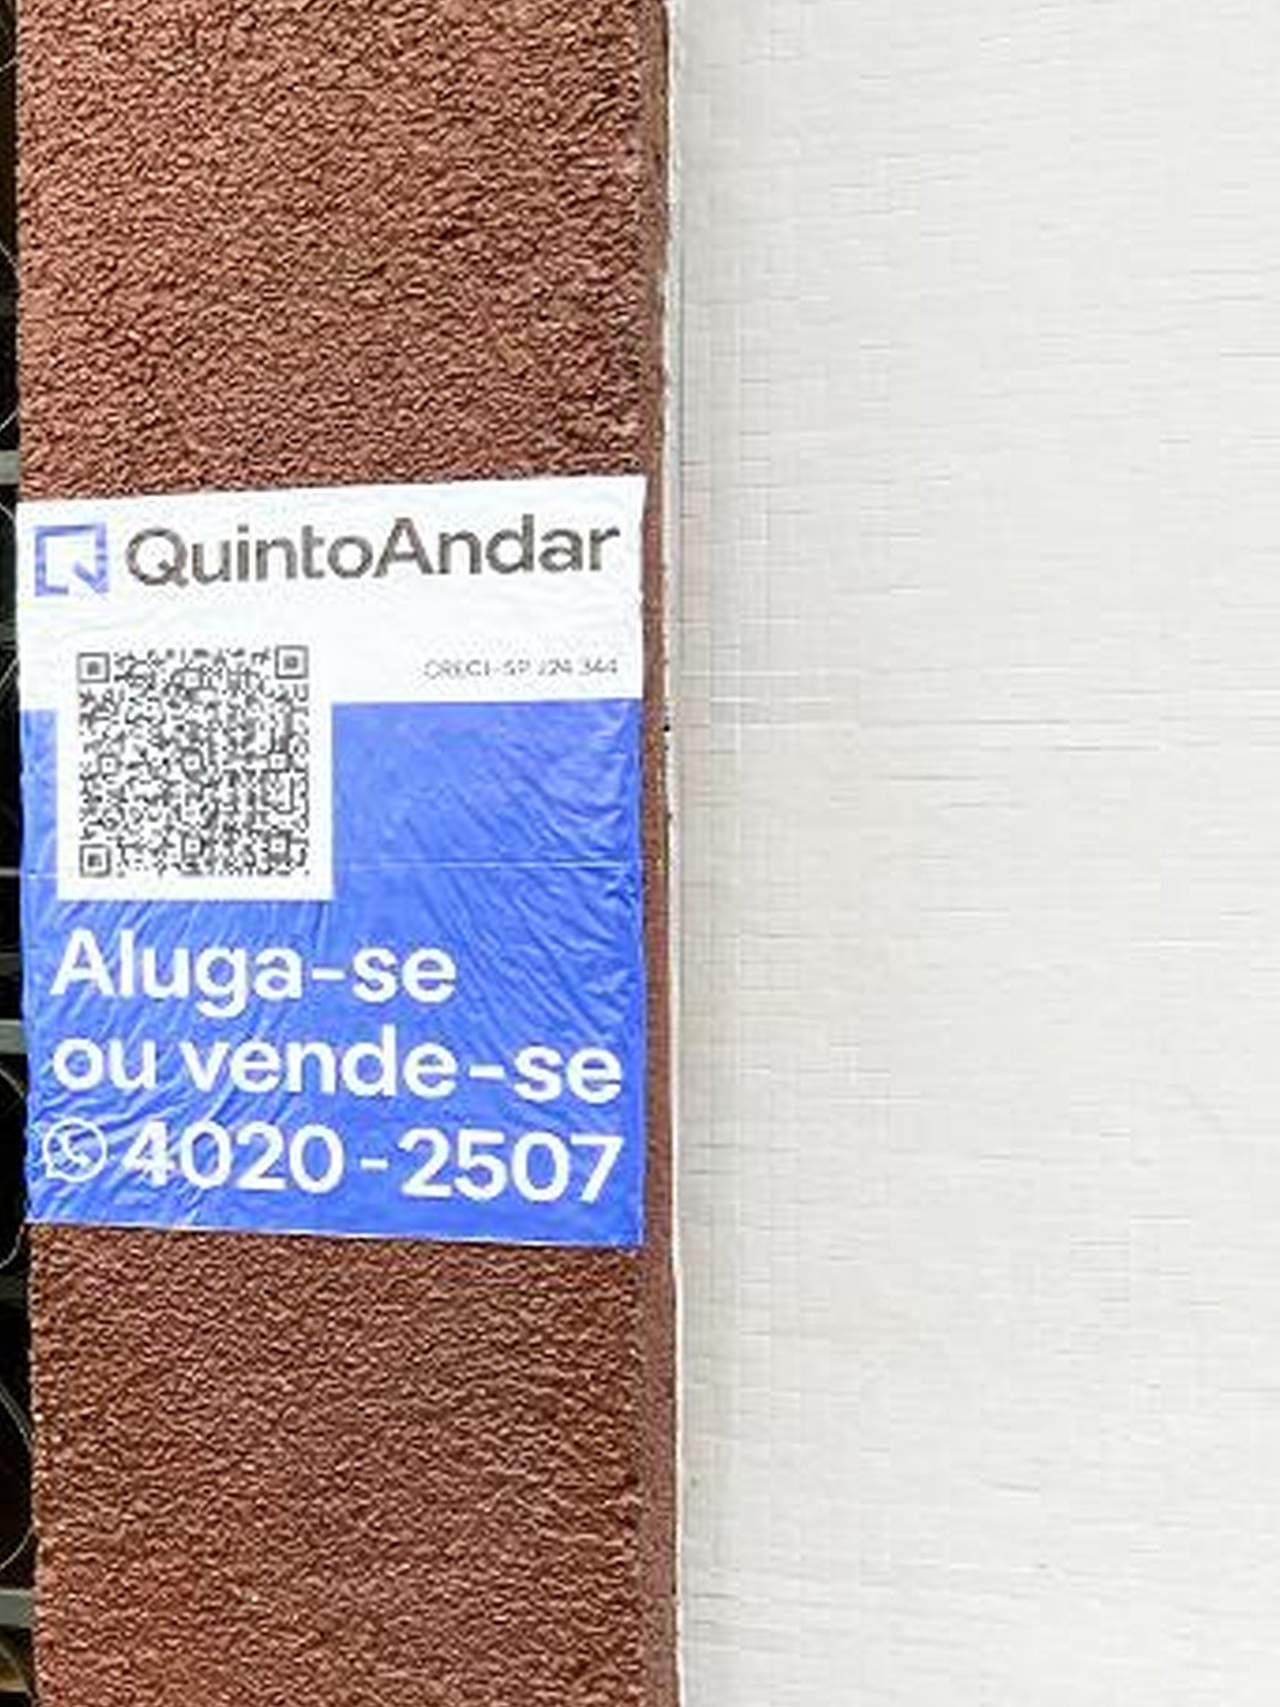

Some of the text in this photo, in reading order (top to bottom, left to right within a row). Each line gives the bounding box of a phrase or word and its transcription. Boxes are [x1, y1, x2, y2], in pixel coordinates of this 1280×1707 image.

[125, 514, 621, 588] QuintoAndar
[49, 929, 457, 1018] Aluga-se
[51, 1024, 623, 1102] ou vende-se
[122, 1119, 625, 1202] 4020-2507
